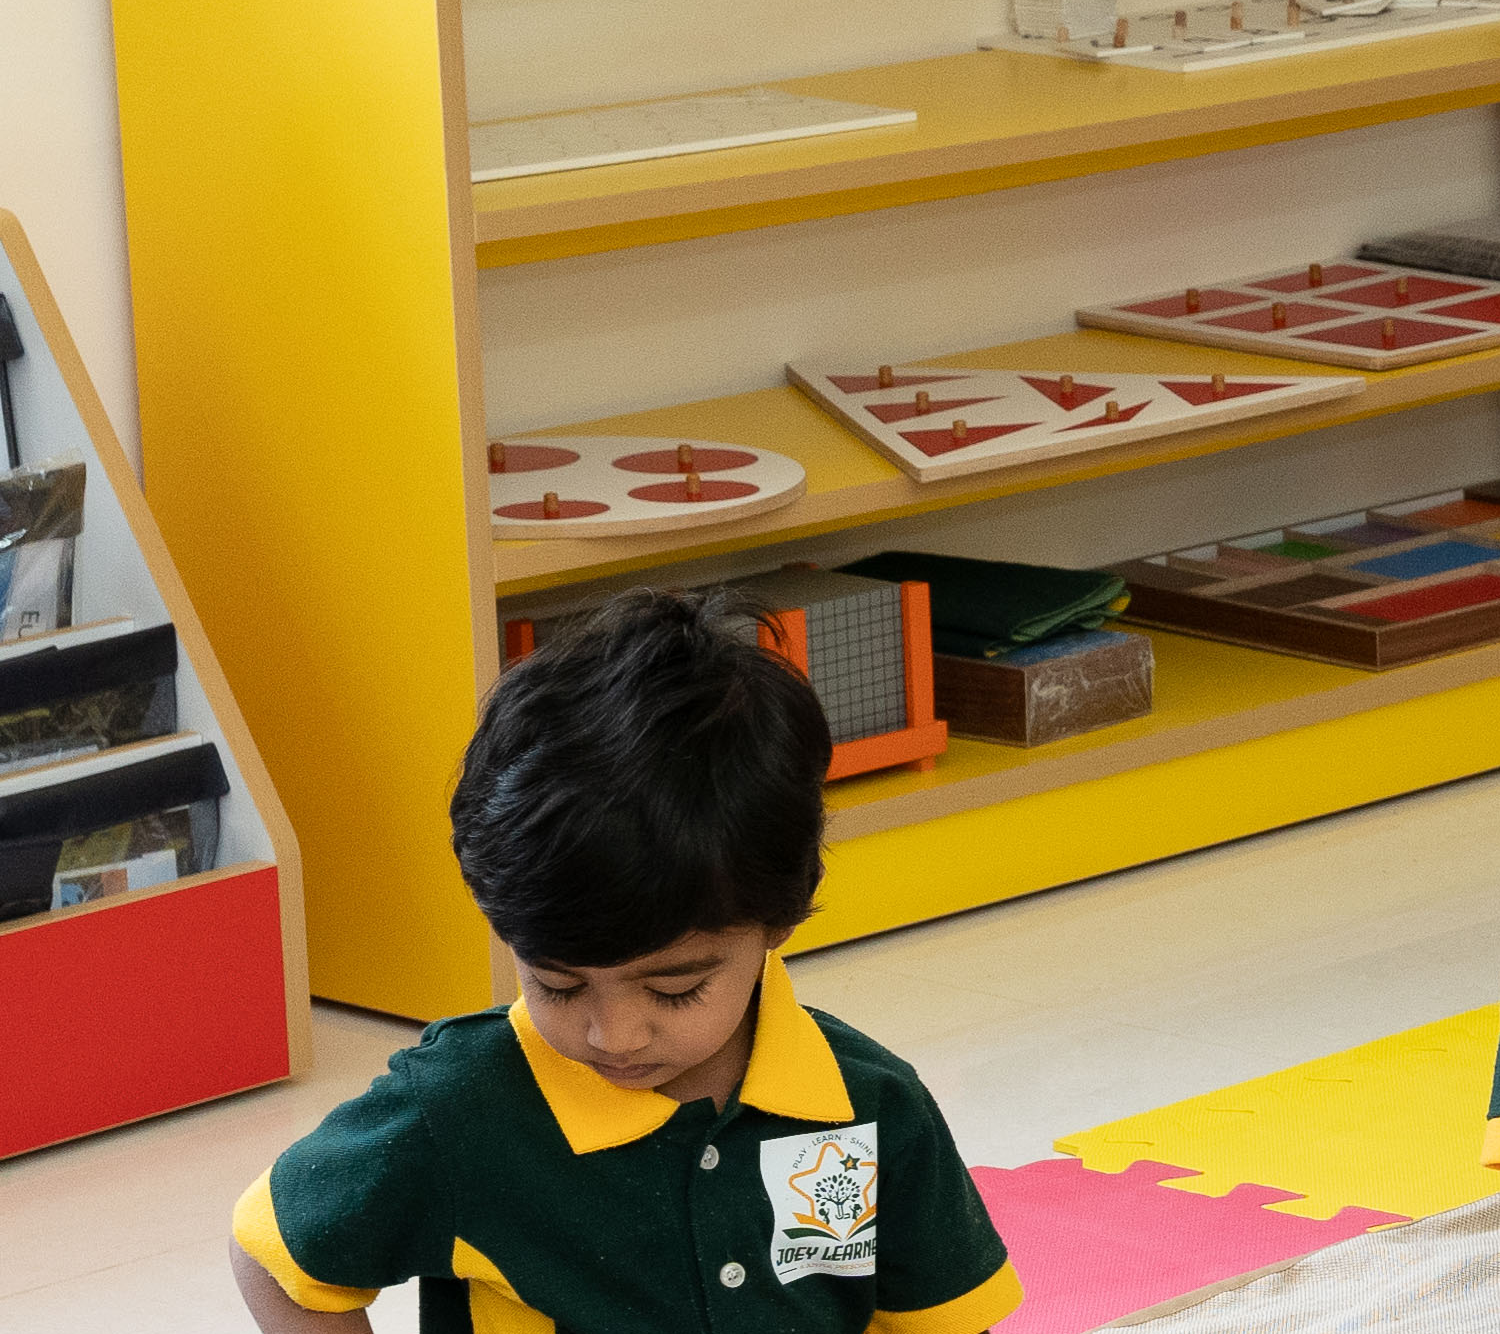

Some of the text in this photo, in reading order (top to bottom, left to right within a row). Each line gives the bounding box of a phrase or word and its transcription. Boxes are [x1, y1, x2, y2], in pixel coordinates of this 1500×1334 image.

[792, 1133, 874, 1169] PLAY LEARN SHINE
[775, 1246, 820, 1267] JOEY
